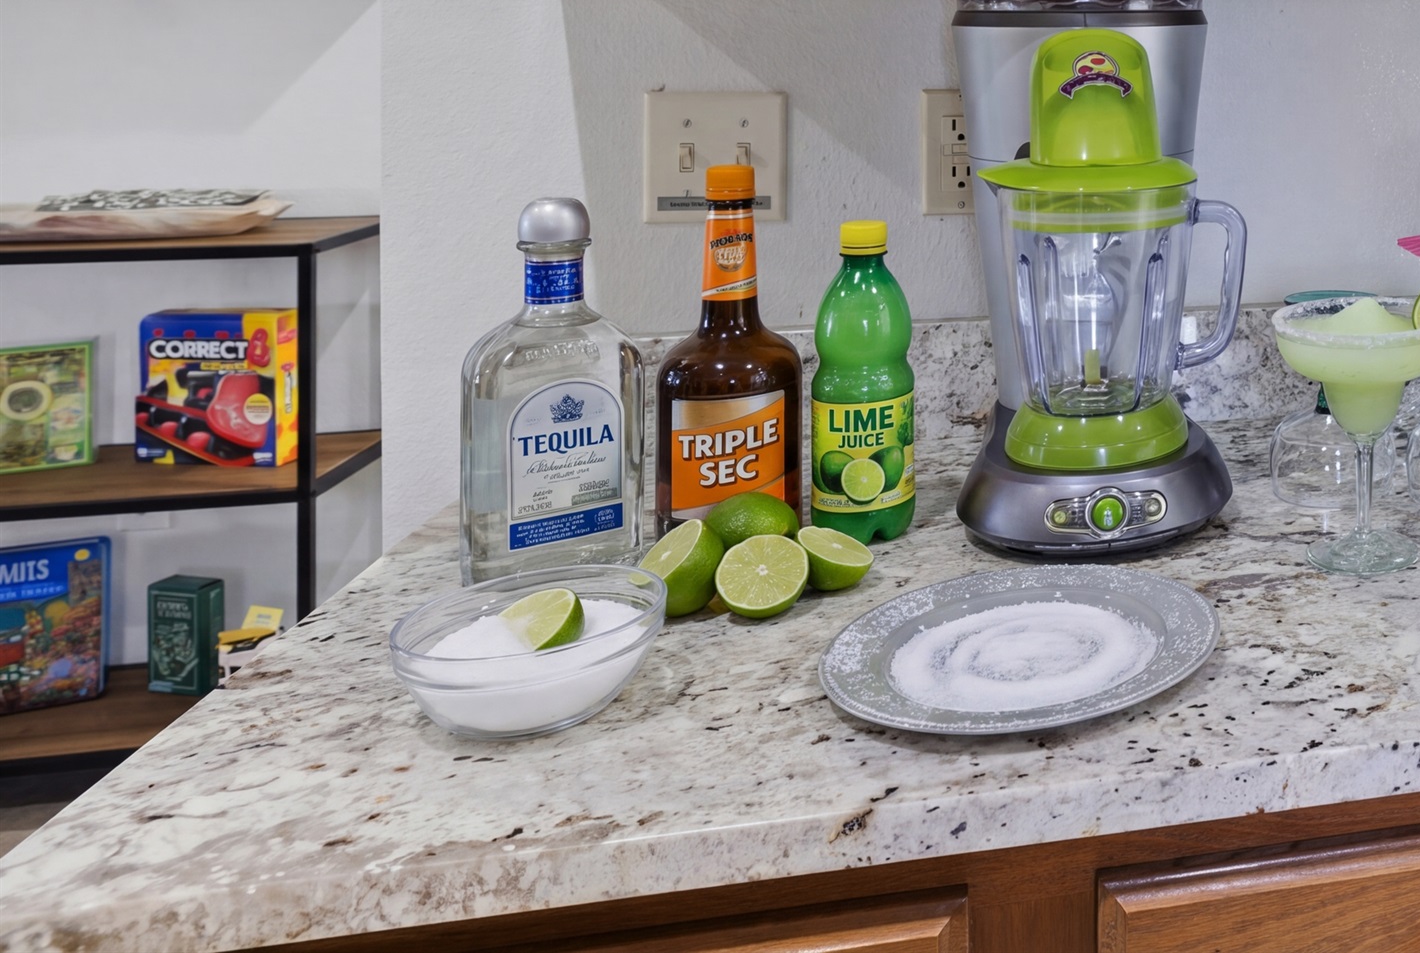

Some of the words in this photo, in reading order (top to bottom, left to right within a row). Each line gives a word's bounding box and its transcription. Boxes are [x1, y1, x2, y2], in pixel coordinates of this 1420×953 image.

[150, 339, 248, 359] CORRECT
[828, 404, 895, 434] LIME
[517, 424, 615, 457] TEQUILA
[678, 418, 779, 460] TRIPLE
[837, 432, 885, 449] JUICE
[699, 453, 758, 488] SEC
